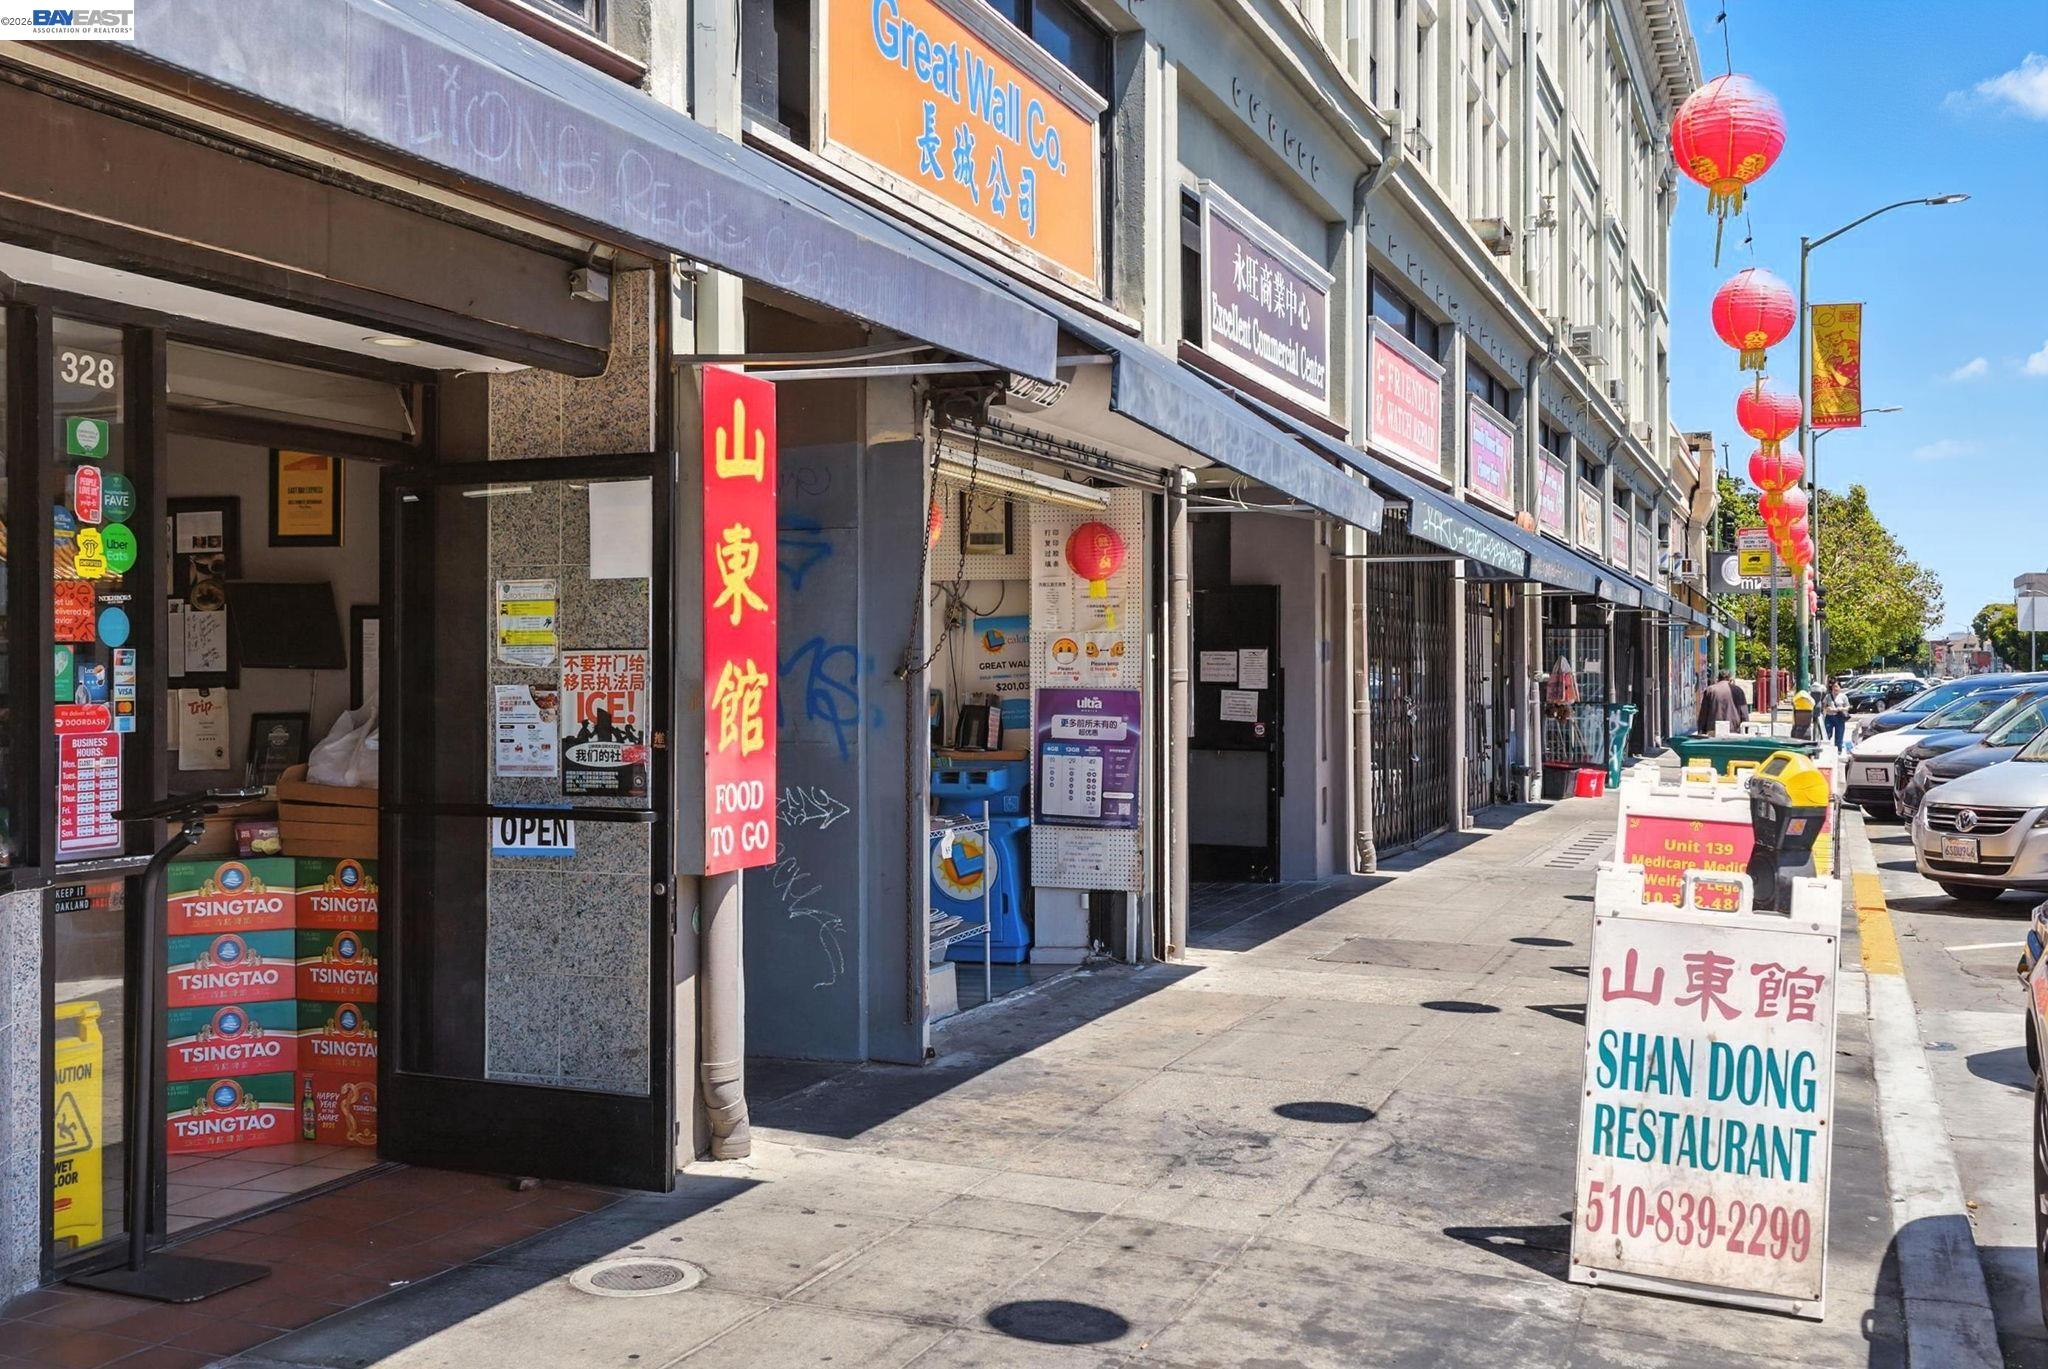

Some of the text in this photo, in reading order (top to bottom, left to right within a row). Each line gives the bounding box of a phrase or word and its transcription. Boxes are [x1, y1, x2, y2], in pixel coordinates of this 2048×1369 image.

[872, 0, 1067, 176] Great Wall Co.
[917, 100, 1036, 237] 長城公司
[1232, 243, 1311, 331] 永旺商業中心
[1212, 291, 1325, 389] Excellent Commercial Center
[60, 350, 115, 389] 328
[1387, 362, 1436, 421] FRIENDLY
[104, 495, 129, 507] FAVE
[106, 539, 129, 550] Uber
[106, 551, 128, 560] Eats
[712, 397, 769, 757] 山東館
[563, 654, 645, 673] 不要开门给
[979, 661, 1007, 671] GREAT
[118, 687, 133, 695] VISA
[563, 673, 645, 691] 移民执法局
[577, 691, 636, 724] ICE!
[1076, 696, 1103, 710] ultra
[72, 738, 108, 748] BUSINESS
[76, 747, 103, 758] HOURS:
[576, 749, 628, 763] 我们的社
[63, 760, 76, 768] Mon.
[62, 783, 76, 791] Wed.
[715, 779, 764, 815] FOOD
[62, 806, 71, 814] Fri.
[62, 818, 72, 826] Sat.
[61, 829, 75, 837] Sun.
[501, 816, 568, 847] OPEN
[711, 820, 769, 857] TO GO
[1664, 839, 1734, 855] Unit 139
[56, 887, 74, 898] KEEP
[77, 886, 84, 896] IT
[55, 899, 89, 912] OAKLAND
[183, 898, 283, 917] TSINGTAO
[178, 969, 278, 990] TSINGTAO
[1602, 947, 1826, 1023] 山東館
[180, 1041, 281, 1063] TSINGTAO
[1596, 1028, 1816, 1113] SHAN DONG
[316, 1092, 340, 1101] HAPPY
[320, 1100, 337, 1109] YEAR
[175, 1113, 275, 1137] TSINGTAO
[317, 1113, 340, 1122] SNAKE
[1593, 1103, 1817, 1183] RESTAURANT
[1585, 1180, 1811, 1263] 510-839-2299
